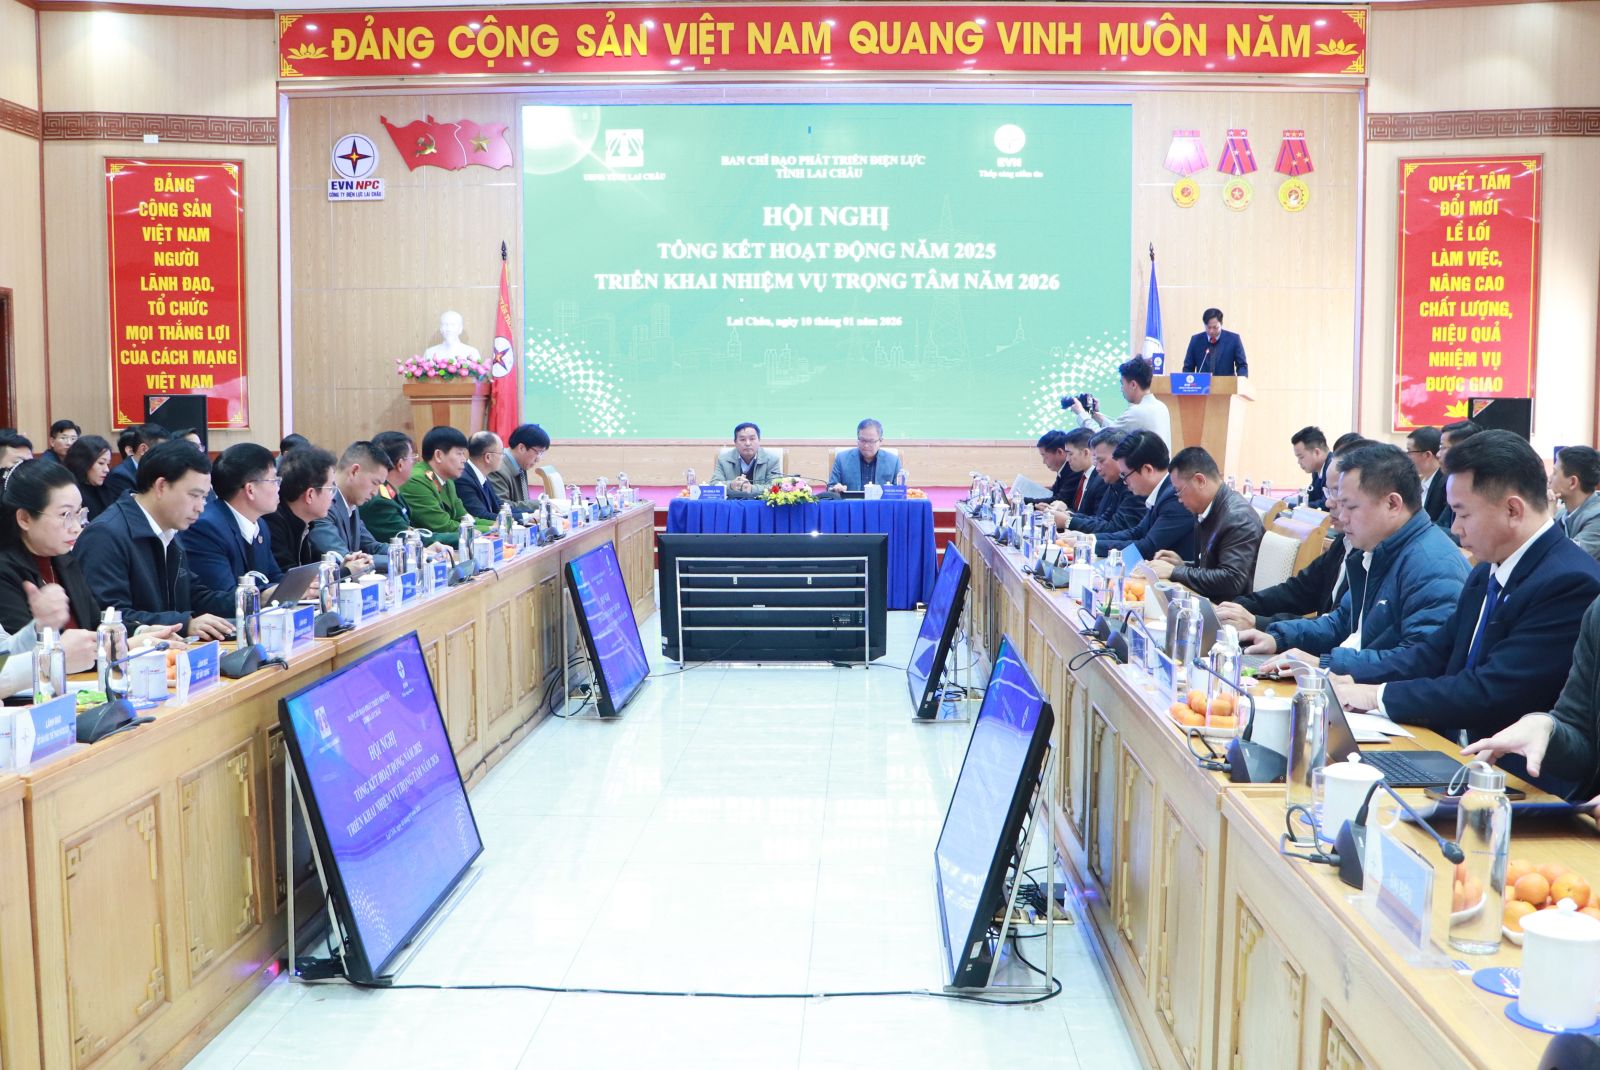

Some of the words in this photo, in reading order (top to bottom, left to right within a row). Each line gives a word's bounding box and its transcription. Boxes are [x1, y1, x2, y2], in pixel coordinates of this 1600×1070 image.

[332, 15, 435, 61] ĐẢNG
[448, 14, 559, 67] CỘNG
[576, 11, 648, 57] SẢN
[664, 13, 734, 64] VIỆT
[748, 22, 830, 54] NAM
[848, 20, 984, 56] QUANG
[997, 21, 1081, 55] VINH
[1099, 12, 1207, 57] MUÔN
[1227, 16, 1311, 58] NĂM
[721, 156, 745, 165] BAN
[154, 172, 195, 193] ĐẢNG
[807, 168, 828, 178] LAI
[1429, 169, 1475, 192] QUYẾT
[1480, 172, 1511, 190] TÂM
[331, 180, 353, 190] EVN
[356, 180, 380, 190] NPC
[139, 198, 178, 220] CỘNG
[183, 197, 212, 218] SẢN
[1440, 193, 1465, 217] ĐỔI
[1469, 195, 1499, 216] MỚI
[763, 203, 813, 231] HỘI
[820, 206, 889, 231] NGHỊ
[142, 223, 173, 245] VIỆT
[177, 227, 210, 242] NAM
[1446, 220, 1464, 241] LỀ
[1468, 219, 1490, 241] LỐI
[154, 248, 199, 267] NGƯỜI
[722, 238, 765, 259] KẾT
[770, 243, 830, 262] HOẠT
[834, 240, 896, 262] ĐỘNG
[900, 239, 950, 259] NĂM
[954, 243, 996, 259] 2025
[1431, 249, 1463, 267] LÀM
[1467, 247, 1503, 269] VIỆC,
[140, 273, 178, 291] LÃNH
[182, 276, 215, 294] ĐẠO,
[664, 273, 717, 289] KHAI
[722, 271, 793, 293] NHIỆM
[798, 273, 827, 293] VỤ
[832, 273, 907, 293] TRỌNG
[911, 268, 959, 289] TÂM
[964, 270, 1013, 289] NĂM
[1018, 274, 1060, 290] 2026
[1429, 273, 1471, 292] NÂNG
[1475, 276, 1505, 292] CAO
[148, 293, 165, 316] TỔ
[169, 298, 209, 316] CHỨC
[1419, 296, 1456, 317] CHẤT
[1461, 300, 1513, 320] LƯỢNG,
[126, 325, 153, 344] MỌI
[158, 320, 203, 340] THẮNG
[207, 325, 230, 344] LỢI
[1431, 323, 1467, 345] HIỆU
[1471, 321, 1501, 343] QUẢ
[120, 343, 149, 365] CỦA
[151, 346, 188, 365] CÁCH
[193, 350, 237, 368] MẠNG
[1429, 348, 1477, 370] NHIỆM
[1481, 352, 1502, 371] VỤ
[146, 372, 176, 393] VIỆT
[180, 374, 214, 389] NAM
[1426, 376, 1465, 396] ĐƯỢC
[1469, 377, 1503, 392] GIAO
